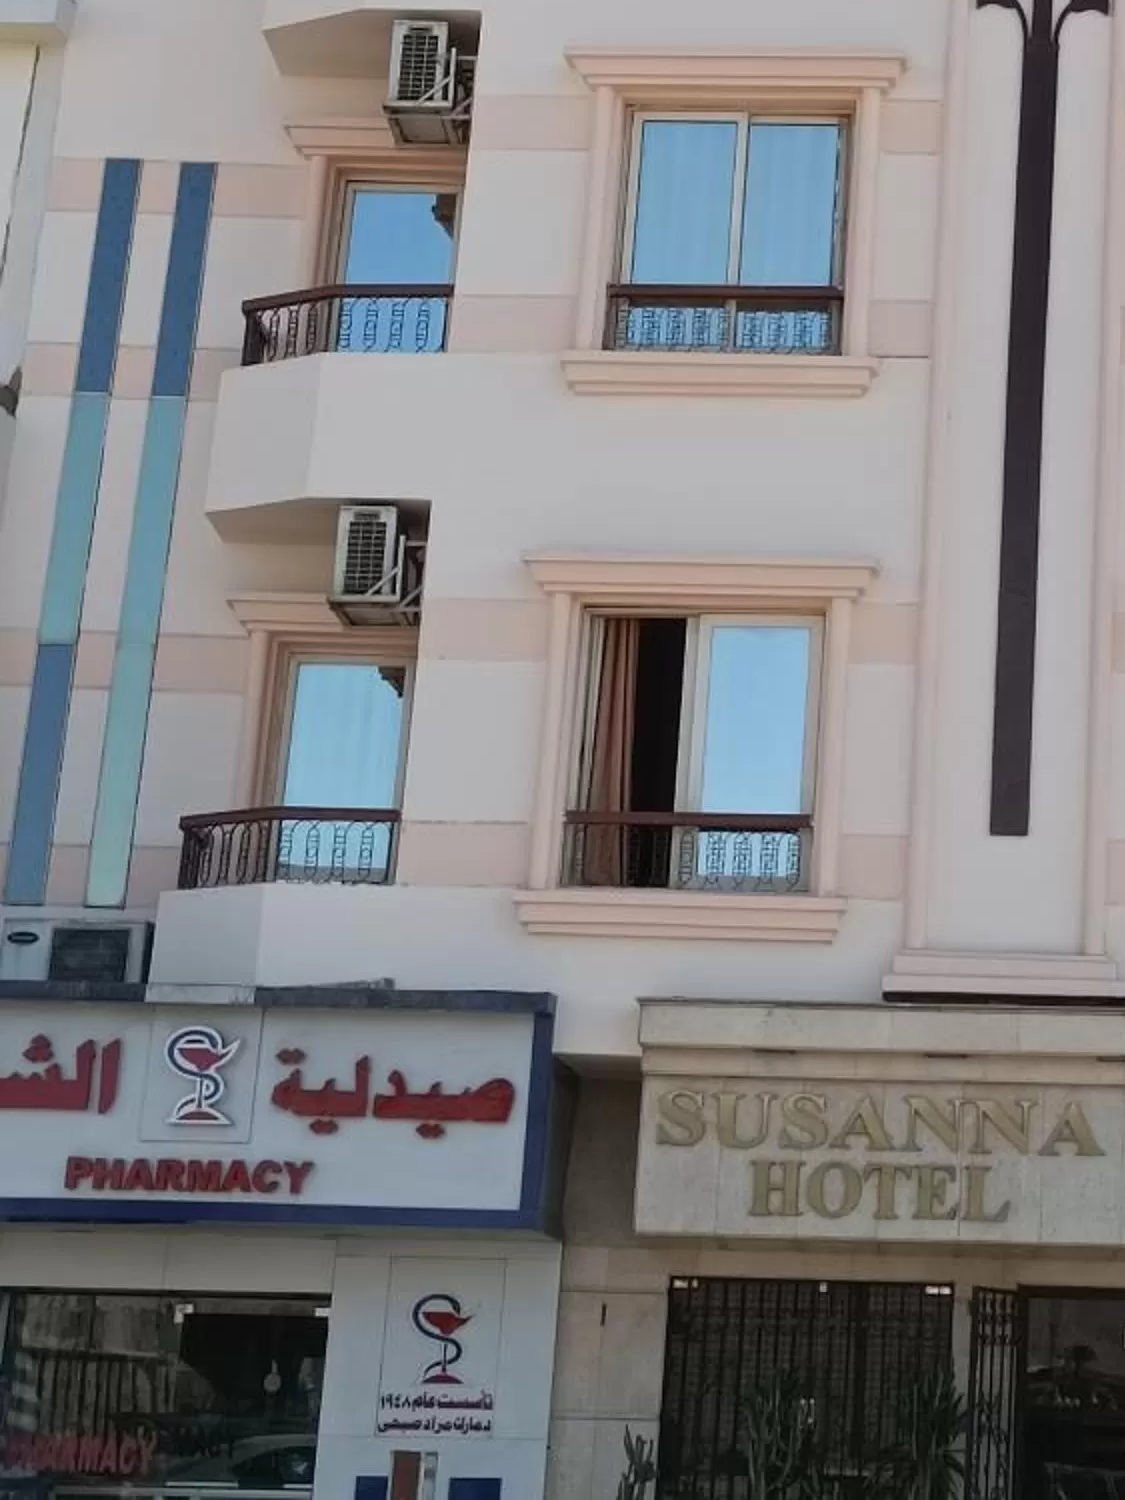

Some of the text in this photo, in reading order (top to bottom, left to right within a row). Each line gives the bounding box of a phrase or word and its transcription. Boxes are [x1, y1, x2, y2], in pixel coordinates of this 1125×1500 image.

[0, 1033, 516, 1139] صيدلية الش
[656, 1090, 1106, 1156] SUSANNA
[64, 1156, 316, 1194] PHARMACY
[747, 1159, 1011, 1222] HOTEL
